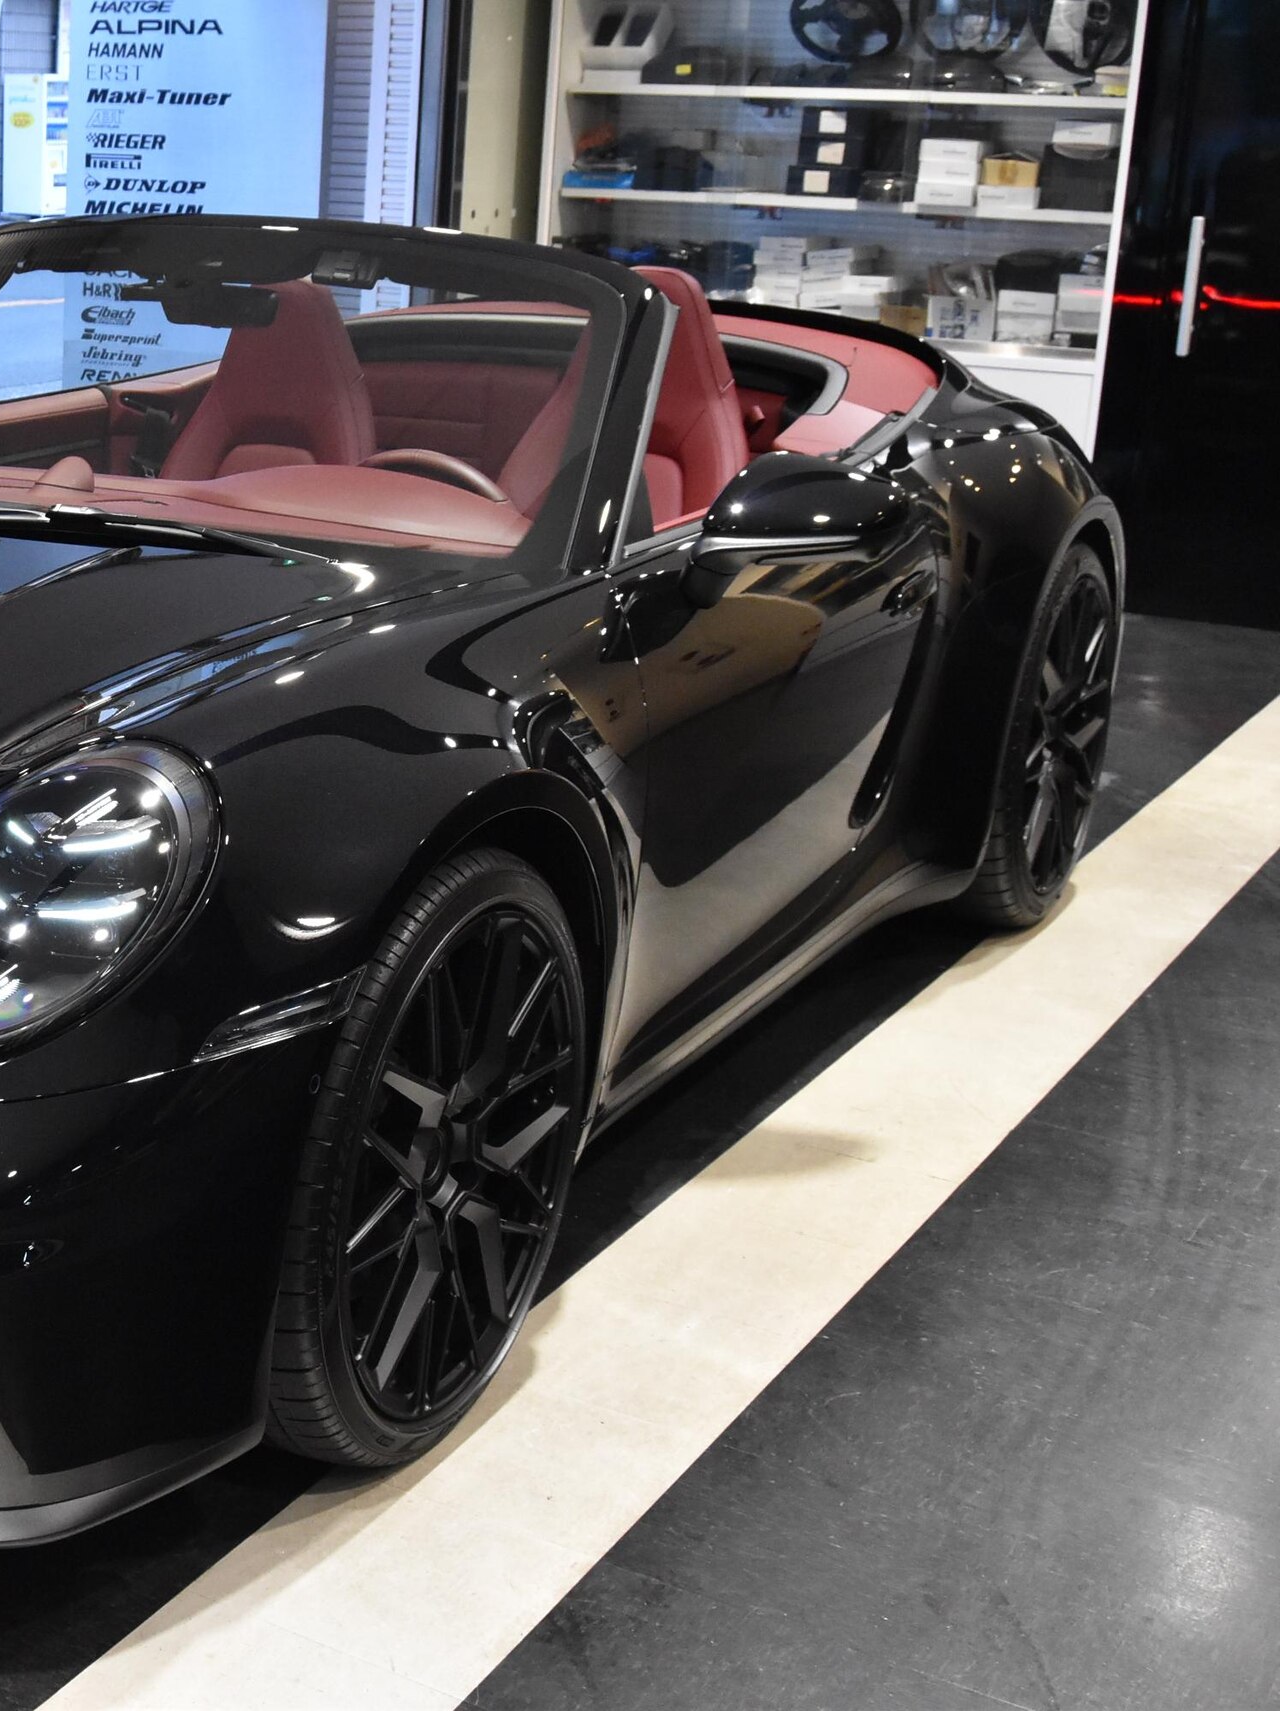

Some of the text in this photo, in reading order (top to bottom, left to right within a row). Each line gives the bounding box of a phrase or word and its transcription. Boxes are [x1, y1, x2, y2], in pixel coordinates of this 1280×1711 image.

[90, 1, 171, 14] HARTGE
[89, 19, 223, 35] ALPINA
[88, 42, 164, 59] HAMANN
[86, 64, 143, 82] ERST
[86, 88, 232, 106] Maxi-Tuner
[93, 132, 167, 150] RIEGER
[85, 153, 142, 170] PIRELLI
[103, 177, 207, 194] DUNLOP
[82, 281, 112, 297] H&R
[81, 305, 136, 326] Eibach
